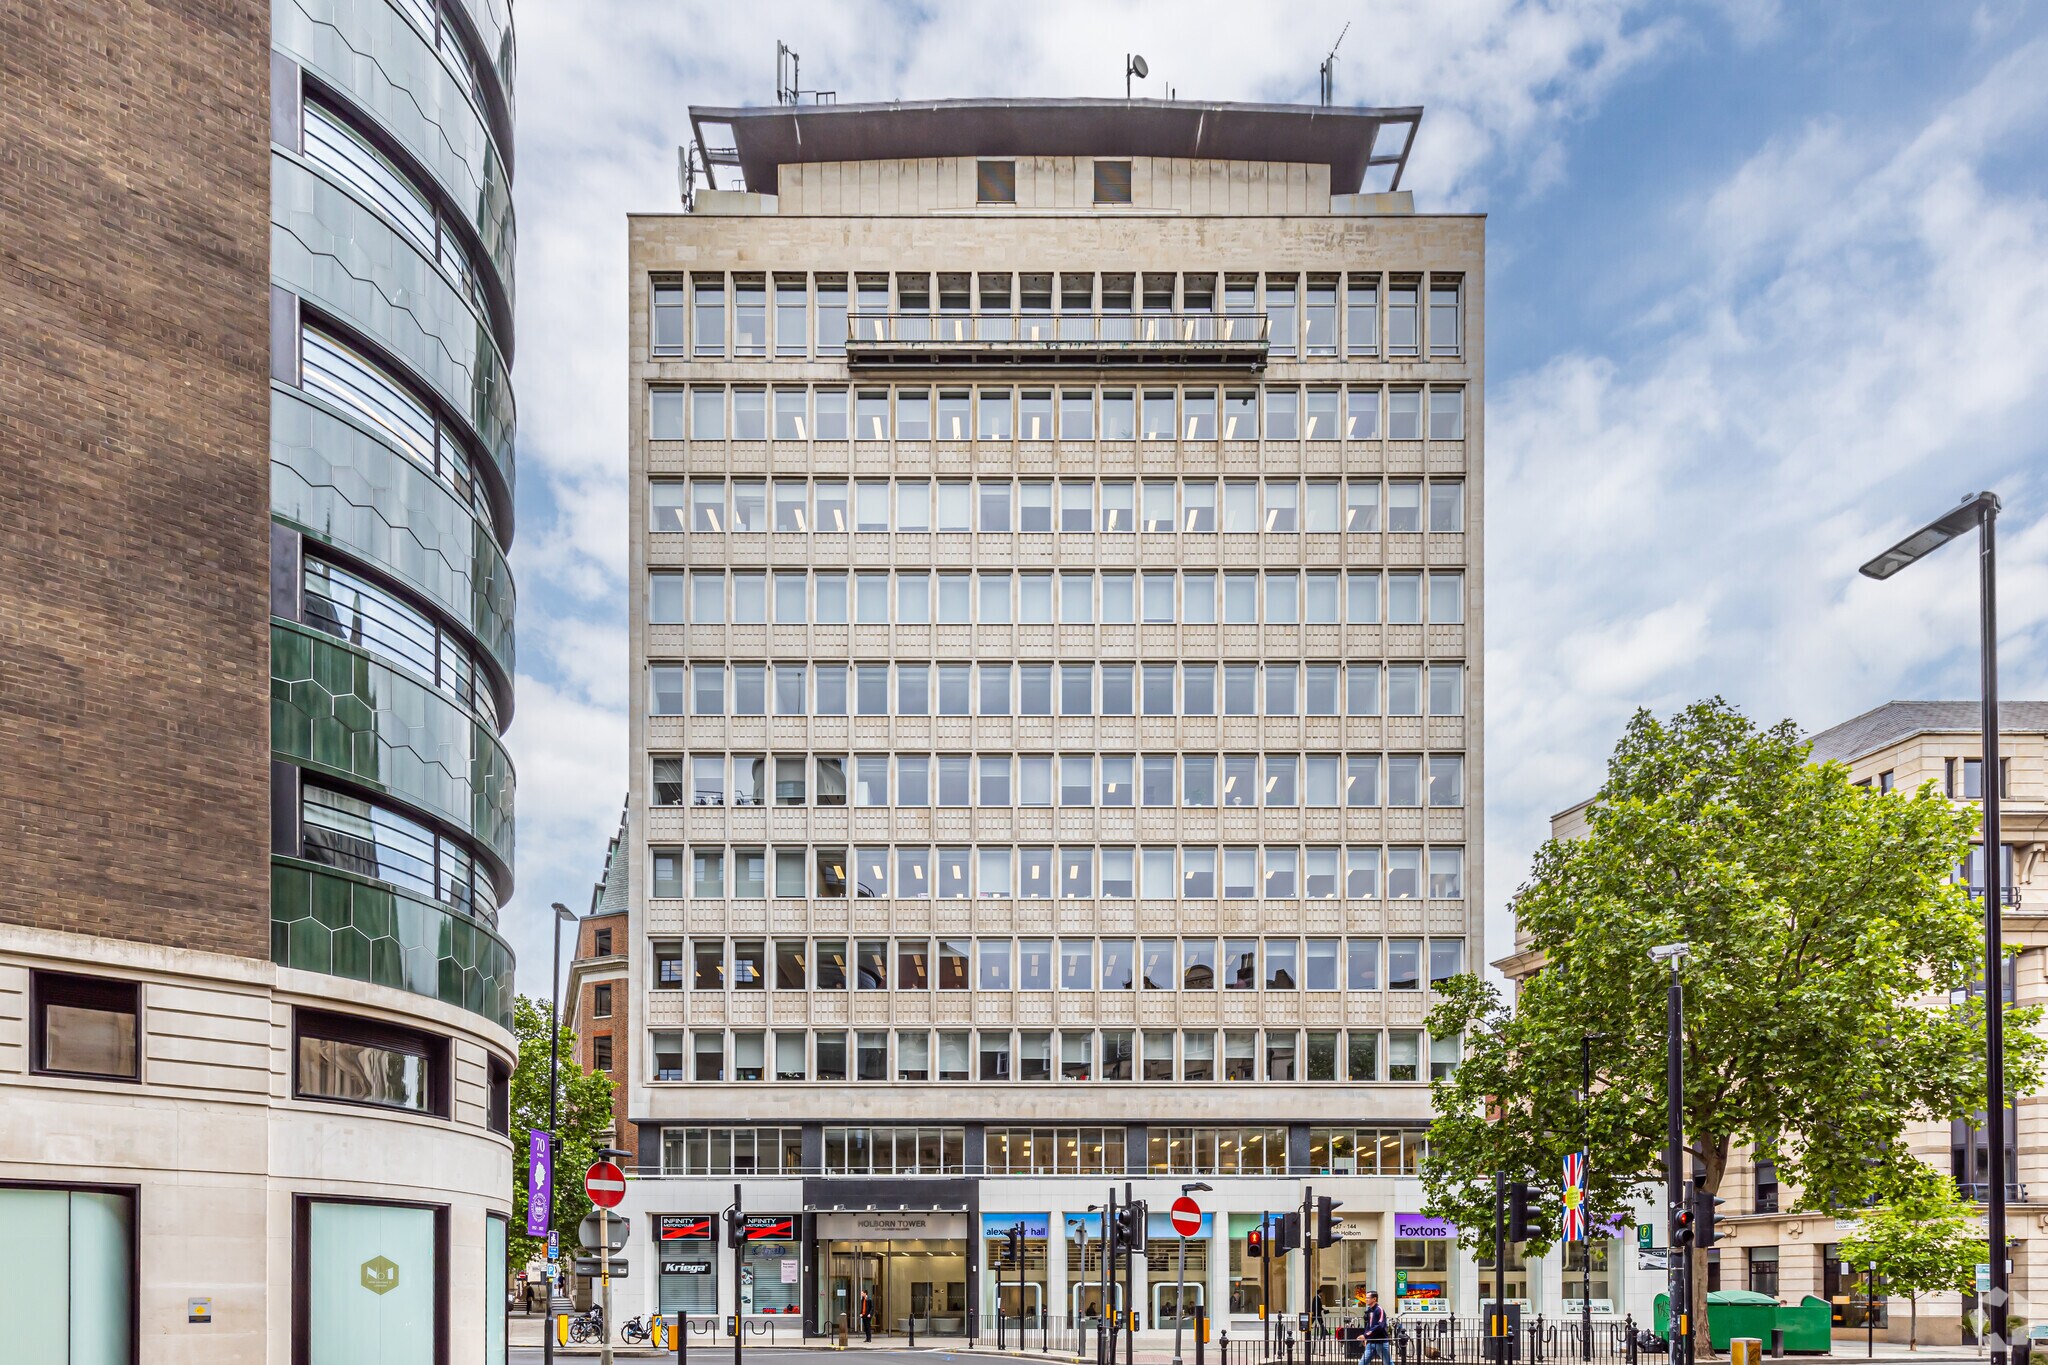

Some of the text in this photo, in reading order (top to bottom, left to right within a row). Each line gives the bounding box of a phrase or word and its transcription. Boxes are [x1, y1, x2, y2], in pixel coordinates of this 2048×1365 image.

[535, 1137, 546, 1153] 70
[857, 1220, 926, 1228] HOLBORN TOWER
[1030, 1227, 1046, 1236] hall
[1399, 1224, 1447, 1237] Foxtons
[664, 1263, 706, 1274] Kriega
